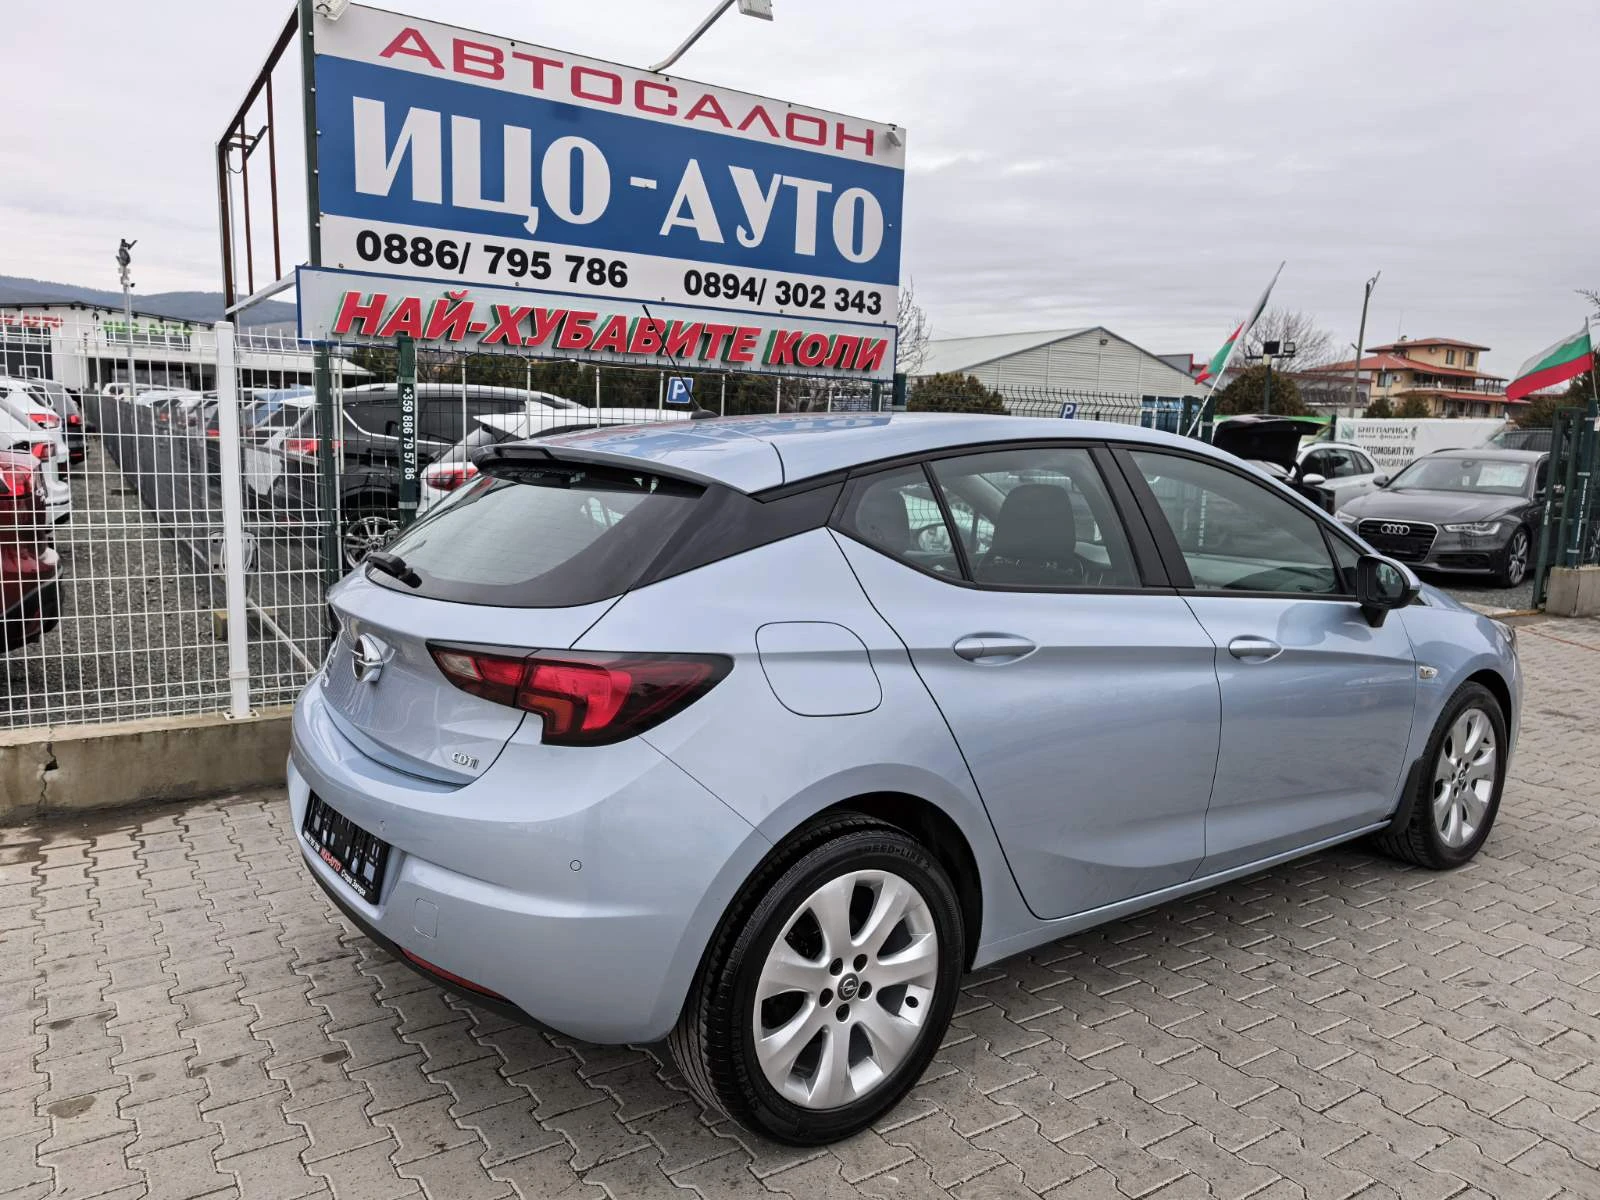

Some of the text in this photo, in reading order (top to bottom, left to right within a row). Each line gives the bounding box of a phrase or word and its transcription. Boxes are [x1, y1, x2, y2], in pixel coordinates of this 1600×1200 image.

[380, 27, 875, 156] АВТОСАЛОН
[356, 230, 628, 288] 0886/ 795 786
[684, 269, 882, 315] 0894/ 302 343
[332, 289, 889, 371] НАЙ-ХУБАВИТЕ КОЛИ
[672, 380, 686, 400] P
[1064, 404, 1074, 419] P
[403, 386, 415, 480] +359 886 79 57 86
